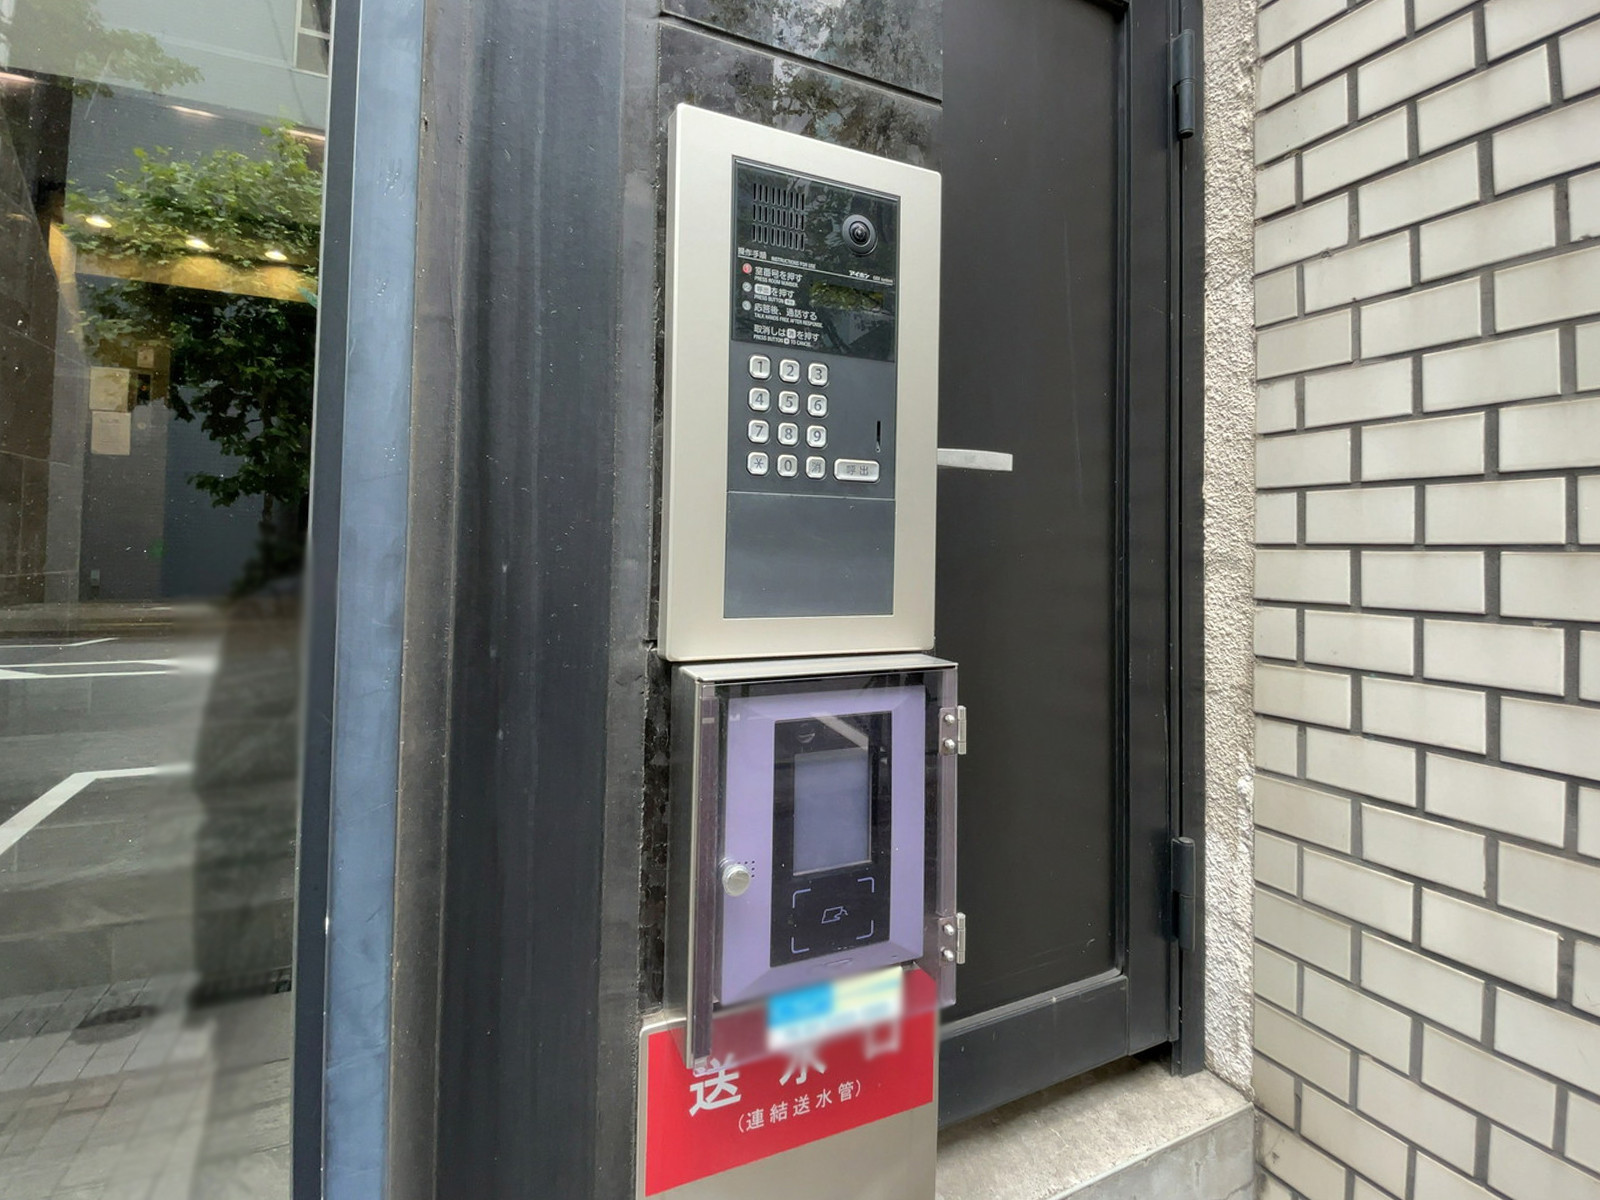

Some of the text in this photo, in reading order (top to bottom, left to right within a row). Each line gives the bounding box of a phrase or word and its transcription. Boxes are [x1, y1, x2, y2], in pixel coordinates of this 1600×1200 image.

[757, 361, 822, 381] 1 2 3
[755, 393, 822, 411] 4 5 6
[755, 425, 822, 442] 7 8 9
[784, 459, 792, 471] 0
[846, 464, 869, 476] 呼出
[738, 1079, 861, 1133] （連結送水管）
